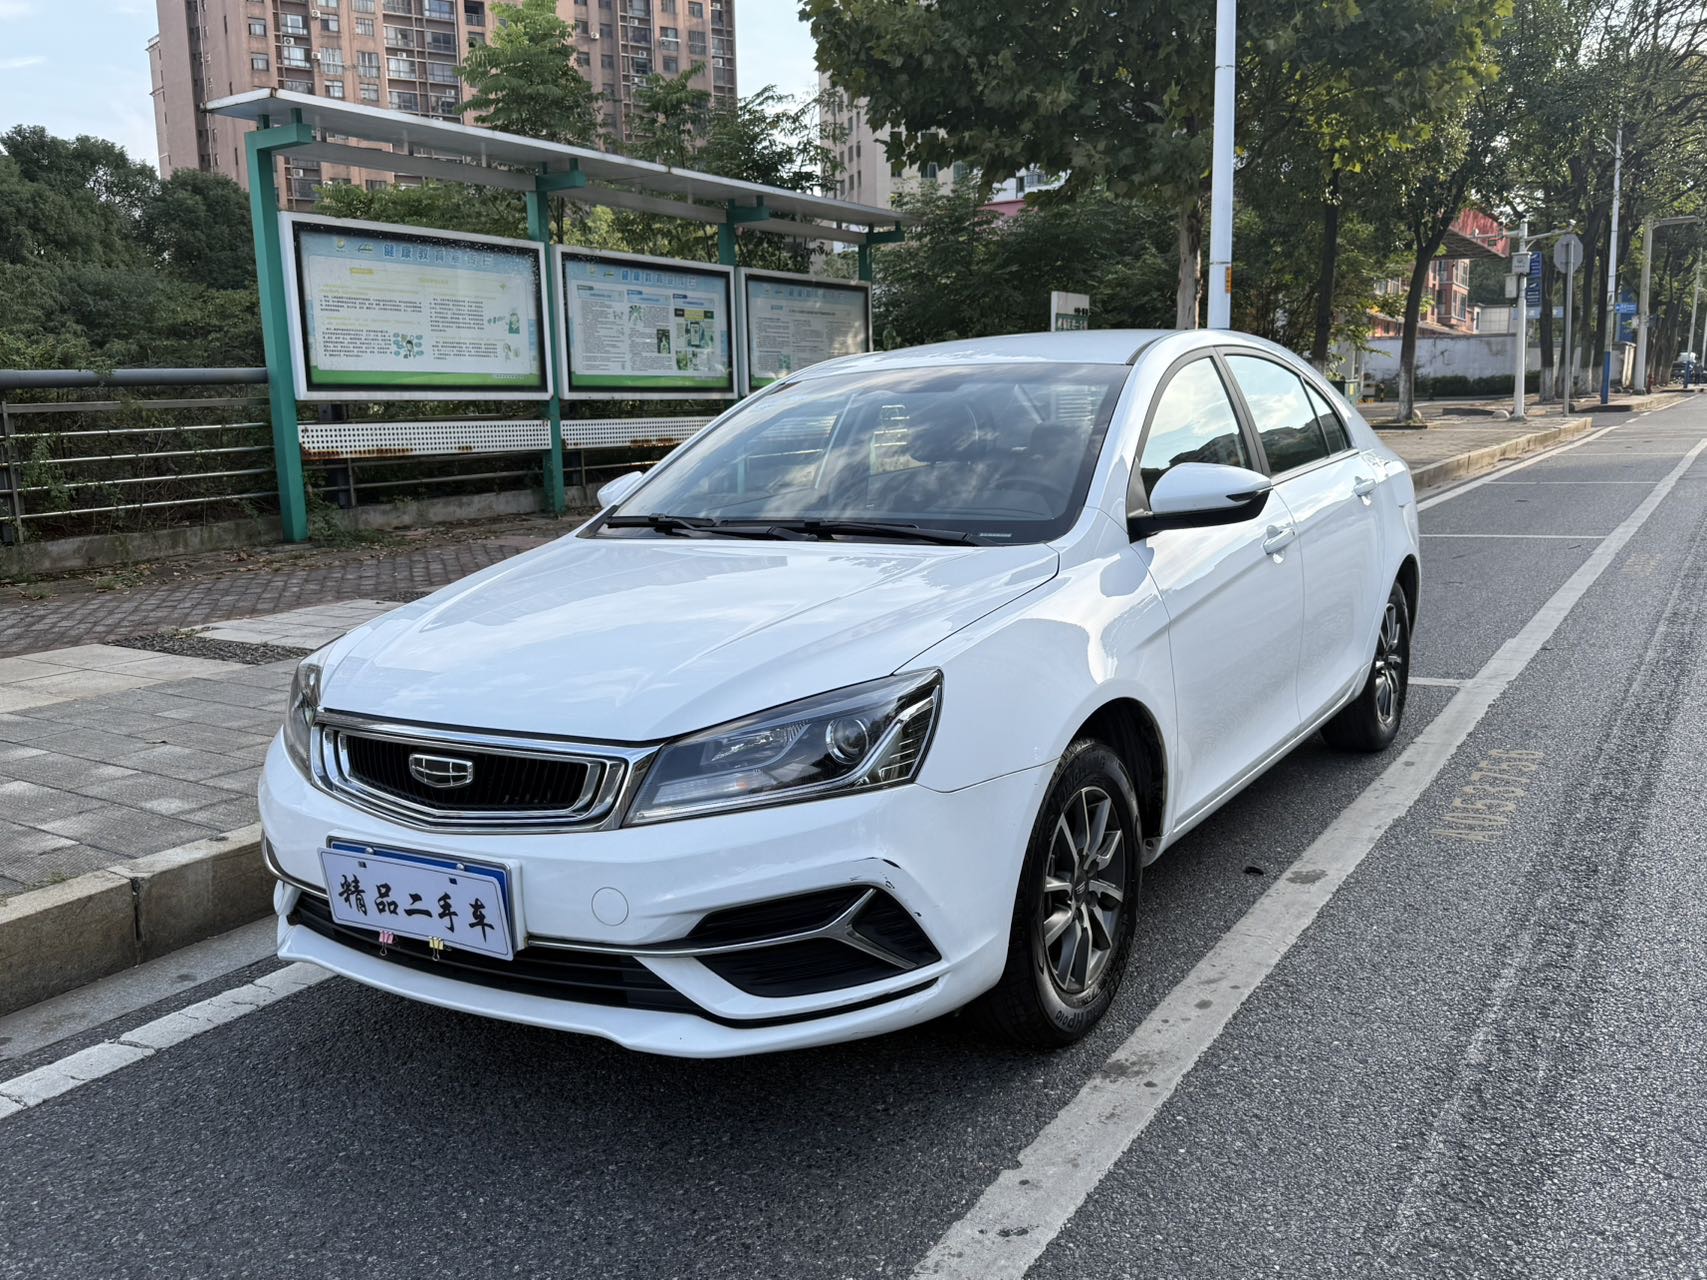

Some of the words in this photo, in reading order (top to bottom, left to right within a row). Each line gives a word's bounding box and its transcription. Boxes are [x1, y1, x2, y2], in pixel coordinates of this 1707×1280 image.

[338, 874, 495, 942] 精品二手车
